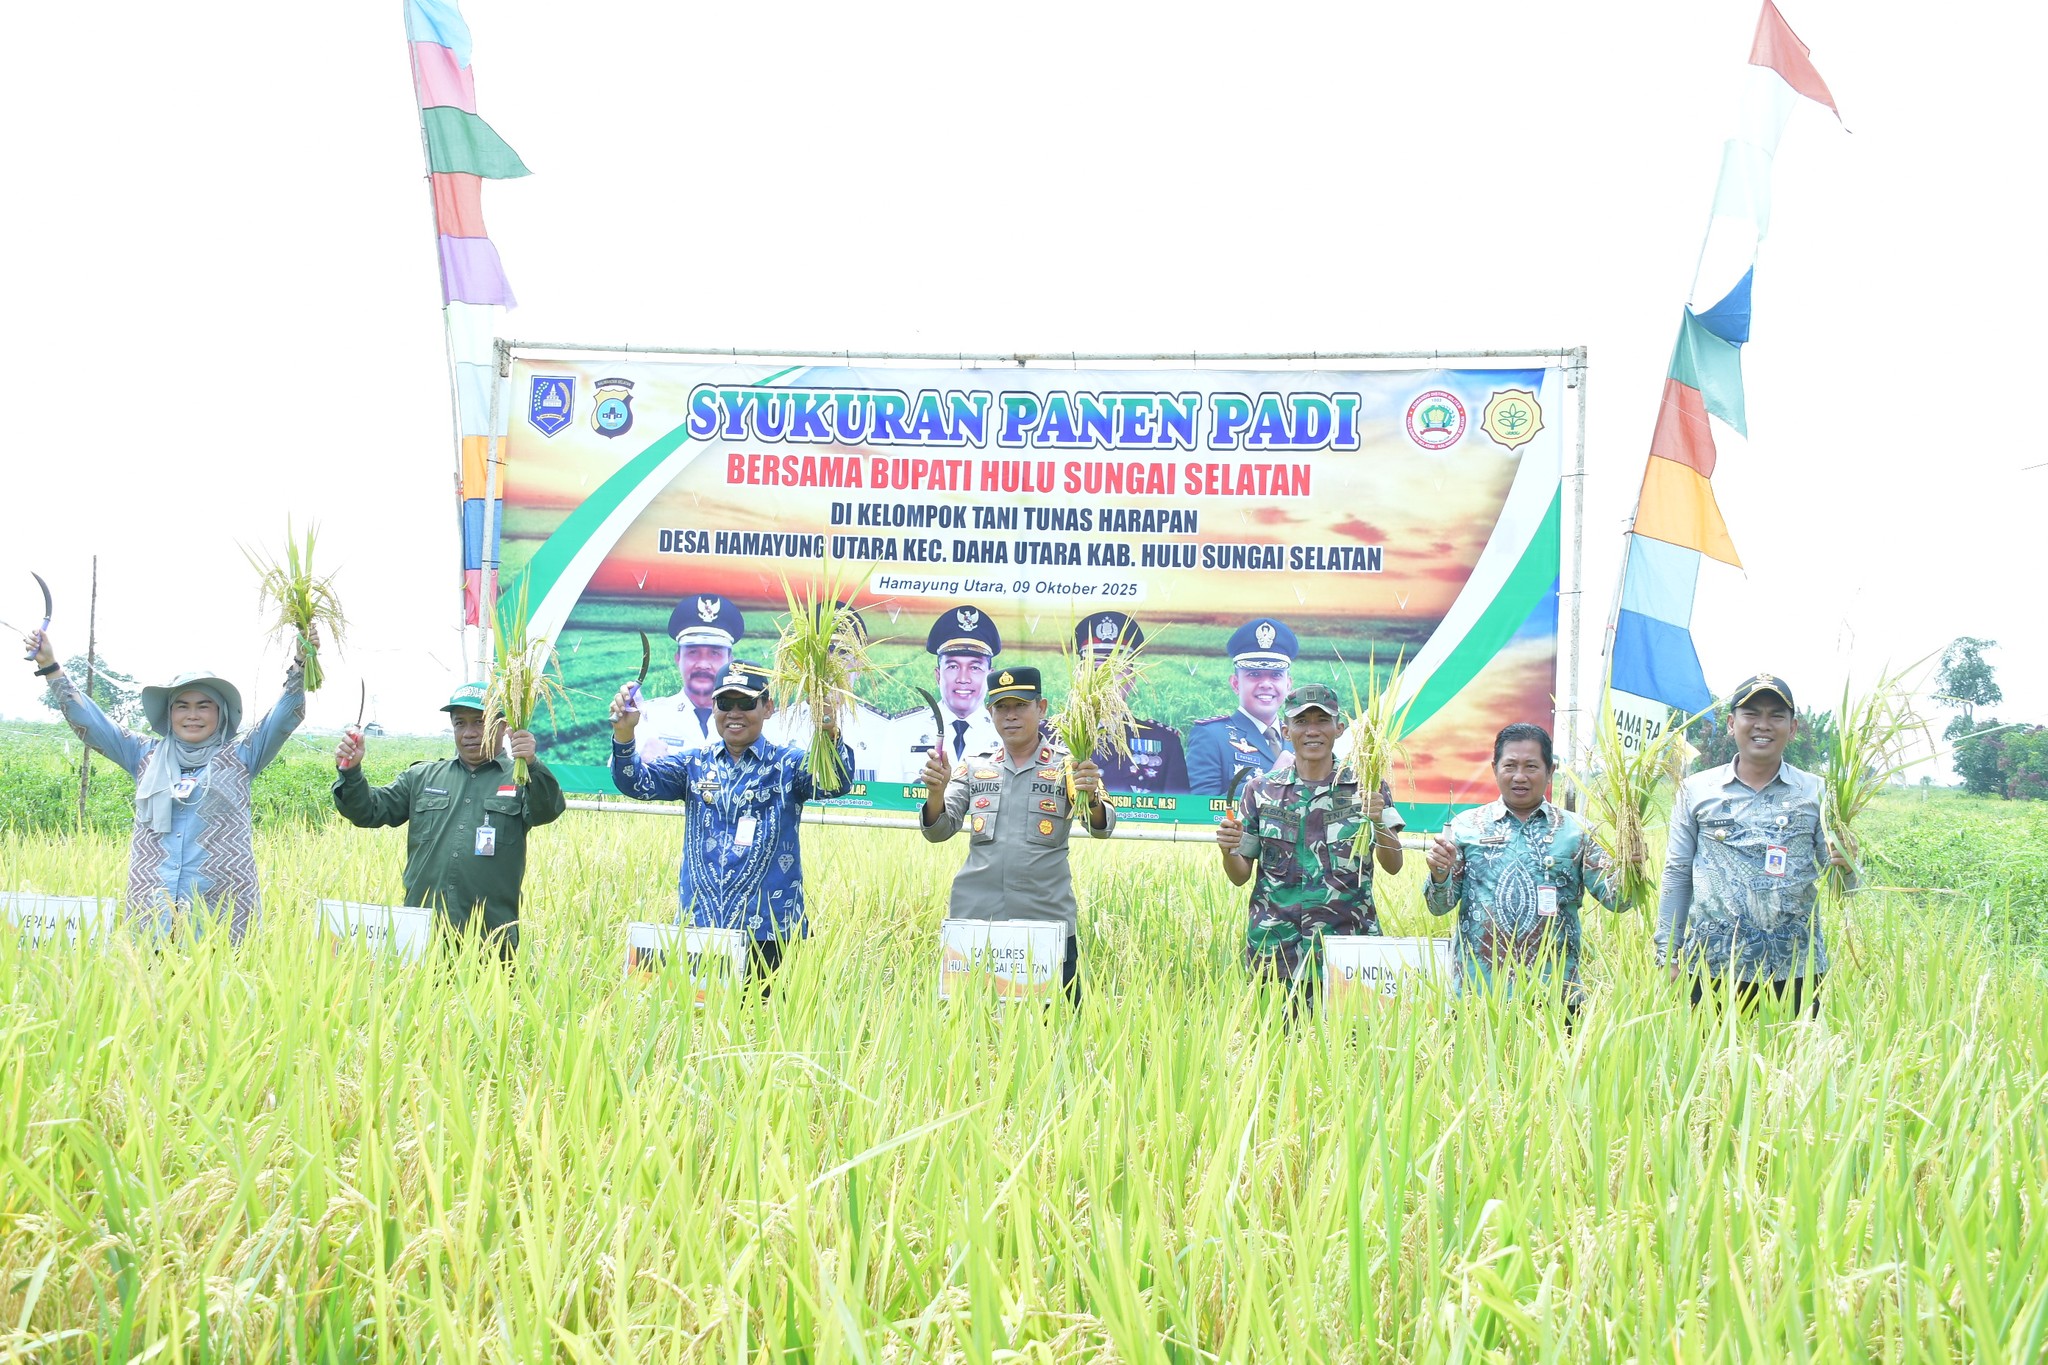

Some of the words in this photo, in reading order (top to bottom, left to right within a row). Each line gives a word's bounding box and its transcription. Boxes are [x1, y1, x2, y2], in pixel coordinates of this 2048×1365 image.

[688, 386, 991, 446] SYUKURAN
[1000, 394, 1199, 448] PANEN
[1210, 394, 1359, 448] PADI
[727, 453, 862, 488] BERSAMA
[871, 457, 972, 490] BUPATI
[980, 460, 1055, 492] HULU
[1064, 461, 1176, 495] SUNGAI
[1184, 463, 1311, 496] SELATAN
[831, 502, 851, 525] DI
[858, 503, 967, 529] KELOMPOK
[972, 505, 1018, 530] TANI
[1024, 507, 1093, 532] TUNAS
[1099, 508, 1198, 534] HARAPAN
[659, 530, 710, 554] DESA
[715, 532, 826, 559] HAMAYUNG
[832, 536, 898, 561] UTARA
[903, 539, 947, 563] KEC.
[952, 540, 1009, 565] DAHA
[1014, 541, 1082, 566] UTARA
[1087, 543, 1136, 568] KAB.
[1141, 544, 1196, 569] HULU
[1202, 545, 1284, 570] SUNGAI
[1290, 547, 1382, 572] SELATAN
[879, 576, 959, 595] Hamayung
[963, 579, 1007, 595] Utara,
[1012, 580, 1031, 594] 09
[1035, 581, 1098, 595] Oktober
[1101, 582, 1138, 596] 2025
[903, 787, 911, 798] H.
[970, 782, 1000, 795] SALVIUS
[1031, 783, 1066, 797] POLRI
[849, 799, 873, 807] Selatan
[1116, 812, 1134, 820] ungai
[970, 947, 1025, 960] KAOLRES
[975, 961, 1008, 974] SNGAI
[1010, 962, 1048, 975] SELTAN
[1345, 965, 1394, 981] DNDIM
